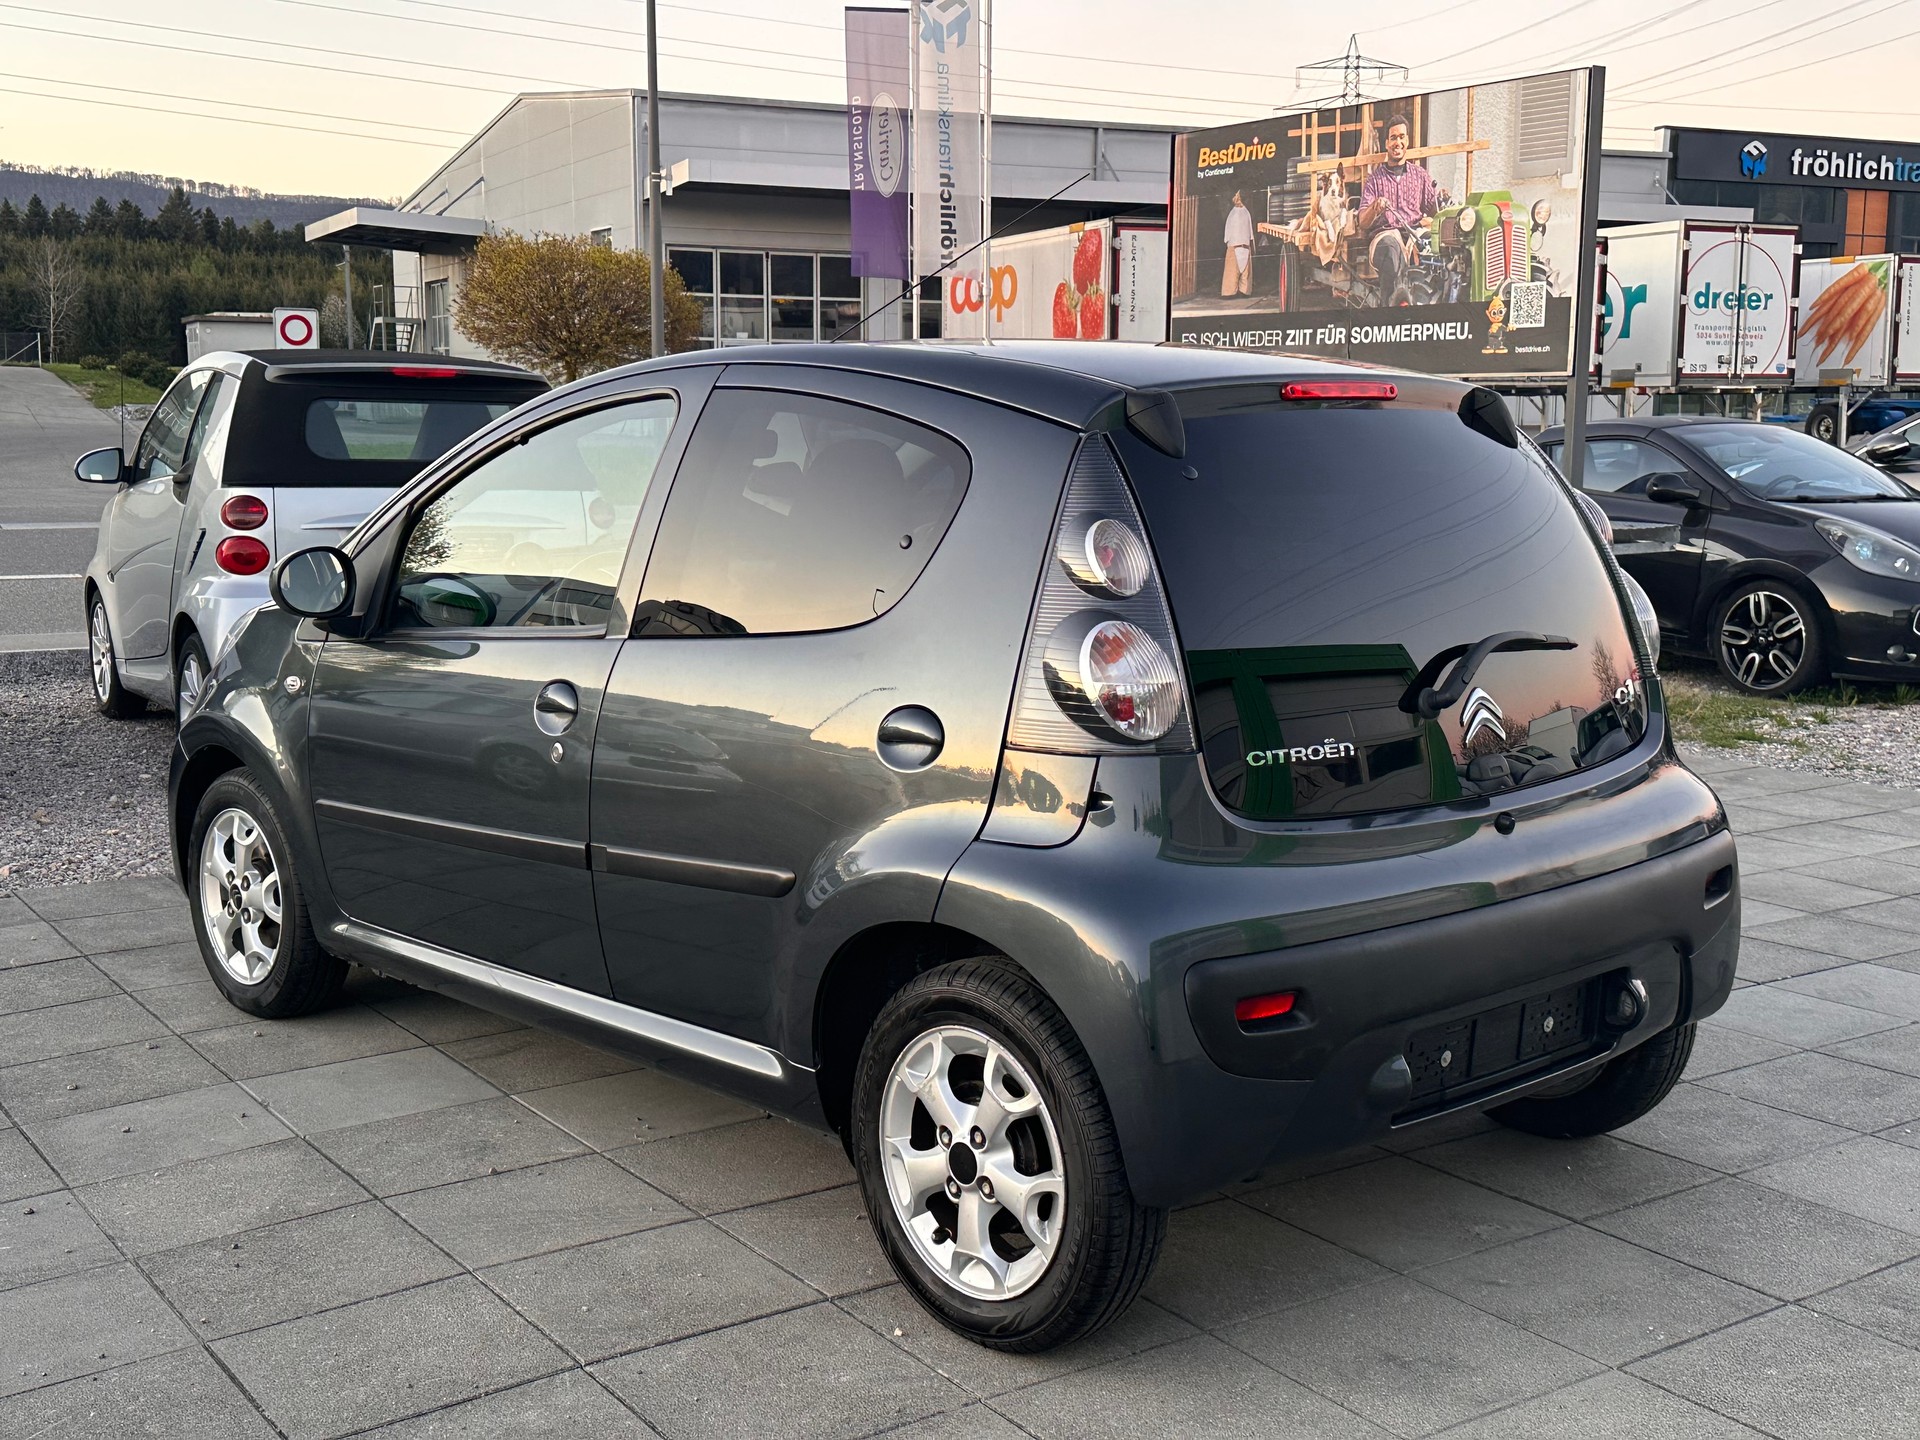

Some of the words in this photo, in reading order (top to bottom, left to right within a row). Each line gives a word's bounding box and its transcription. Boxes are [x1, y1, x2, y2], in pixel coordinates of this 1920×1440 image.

[1198, 136, 1276, 168] BestDrive
[1204, 166, 1234, 178] Continental
[950, 265, 1017, 323] coop
[1694, 282, 1773, 310] dreier
[1200, 331, 1229, 347] ISCH
[1232, 330, 1282, 347] WIEDER
[1285, 329, 1313, 346] ZIIT
[1316, 324, 1346, 345] FÜR
[1350, 322, 1473, 344] SOMMERPNEU.
